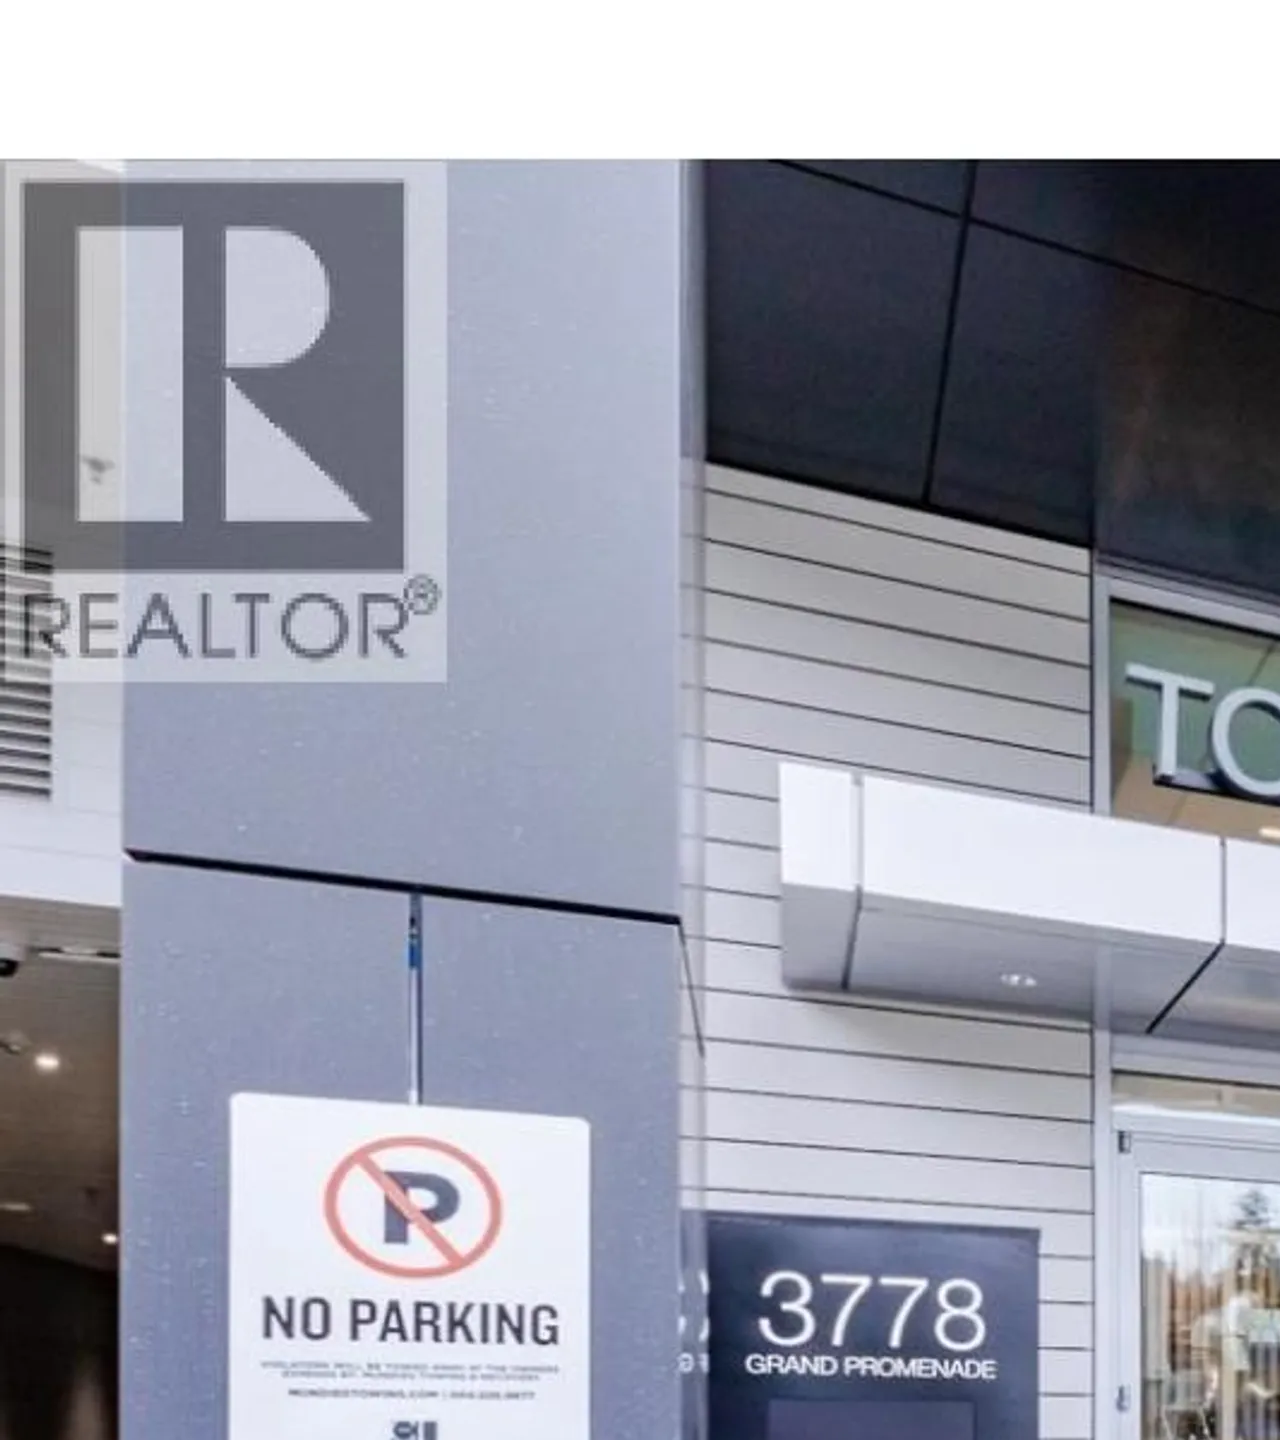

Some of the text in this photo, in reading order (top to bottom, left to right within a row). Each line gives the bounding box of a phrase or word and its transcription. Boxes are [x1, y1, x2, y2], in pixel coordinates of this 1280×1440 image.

[261, 1296, 560, 1346] NO PARKING
[757, 1269, 987, 1352] 3778
[745, 1353, 998, 1381] GRAND PROMENADE
